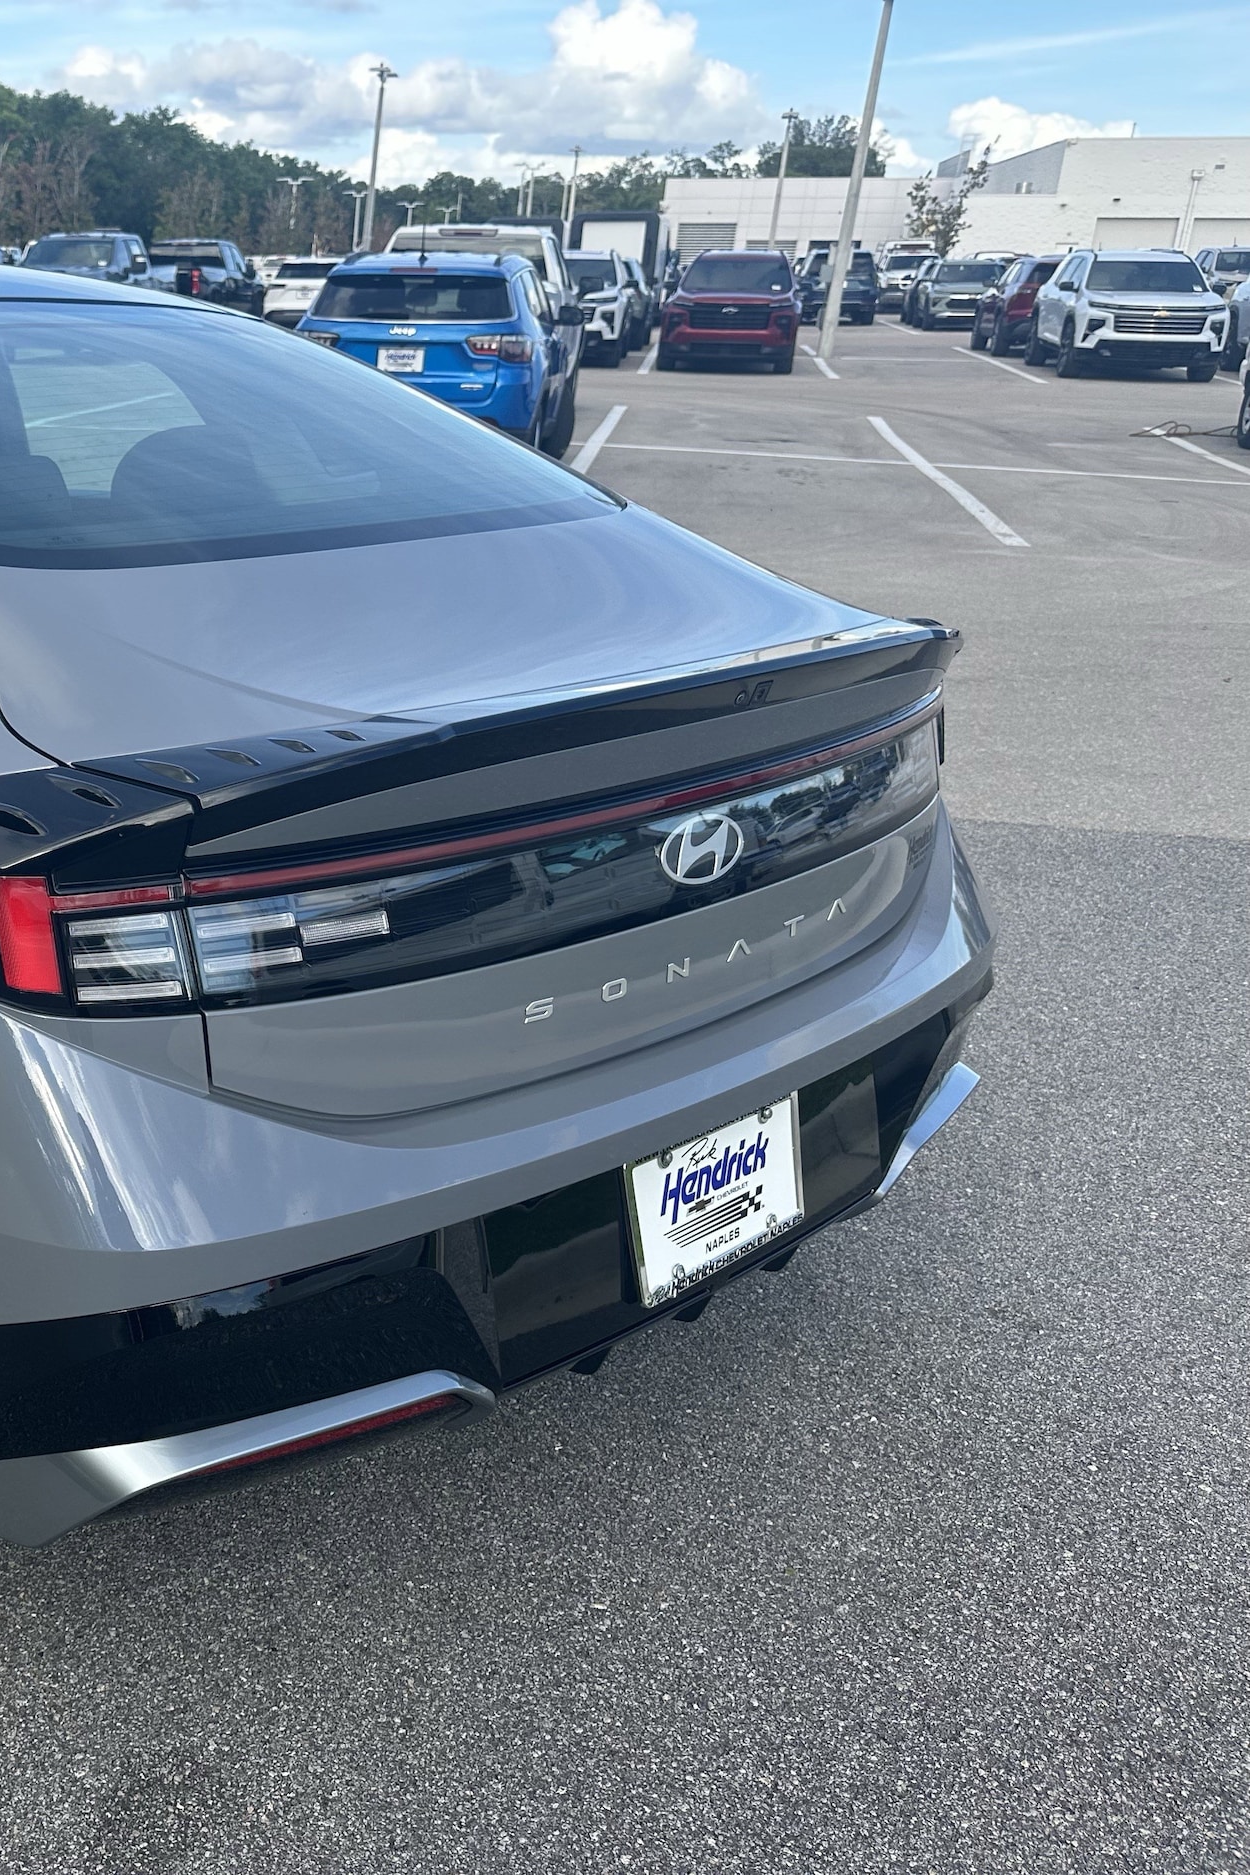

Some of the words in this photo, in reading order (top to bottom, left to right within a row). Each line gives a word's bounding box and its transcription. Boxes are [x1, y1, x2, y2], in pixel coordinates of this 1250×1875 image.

[389, 326, 417, 336] Jeep
[523, 897, 847, 1024] SONATA
[660, 1131, 770, 1226] Hendrick
[716, 1181, 749, 1202] CHEVROLET
[705, 1227, 740, 1254] NAPLES
[714, 1233, 769, 1271] CHEVROLET
[769, 1212, 804, 1240] NAPLES
